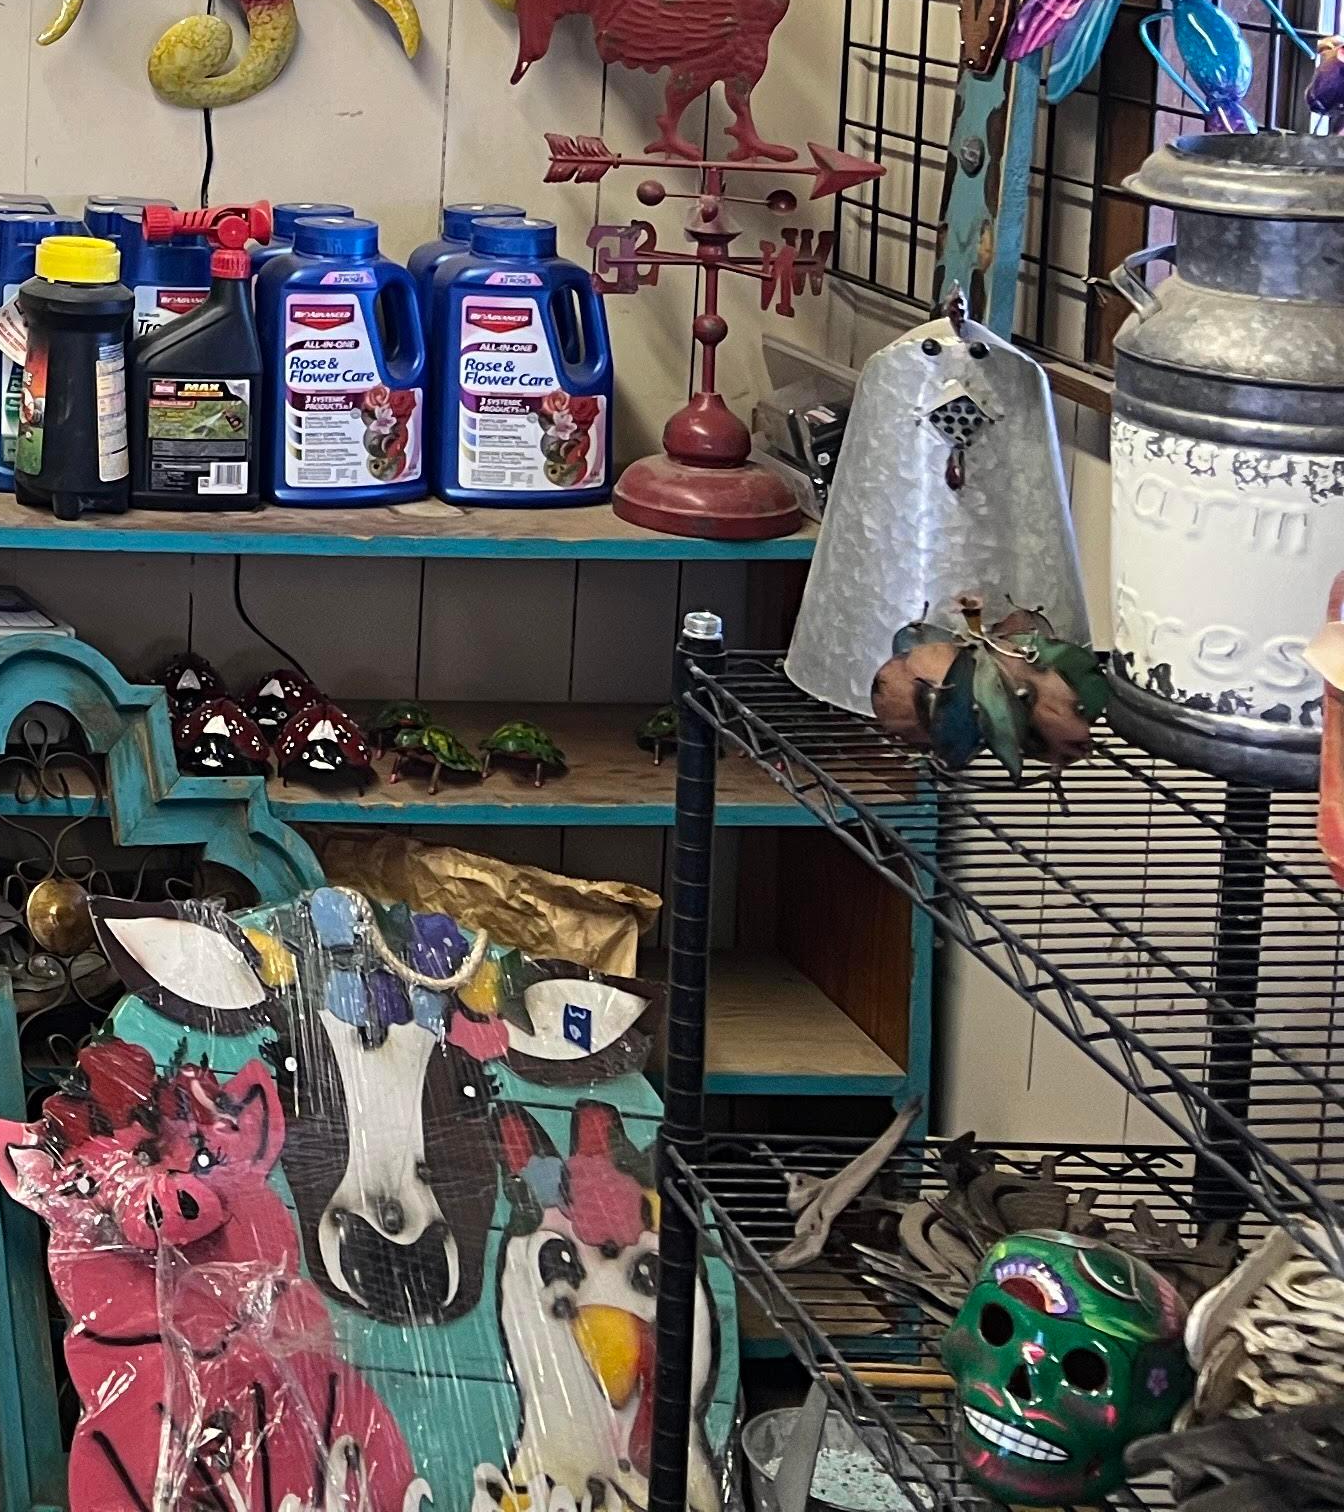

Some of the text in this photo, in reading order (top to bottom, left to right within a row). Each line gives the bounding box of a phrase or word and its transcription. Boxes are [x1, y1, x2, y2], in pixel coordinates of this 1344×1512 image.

[303, 340, 356, 349] ALL-IN-ONE
[479, 343, 533, 353] ALL-IN-ONE
[289, 356, 339, 369] Rose &
[464, 358, 516, 372] Rose &
[289, 369, 375, 383] Flower Care
[464, 372, 554, 386] Flower Care
[184, 383, 220, 392] MAX
